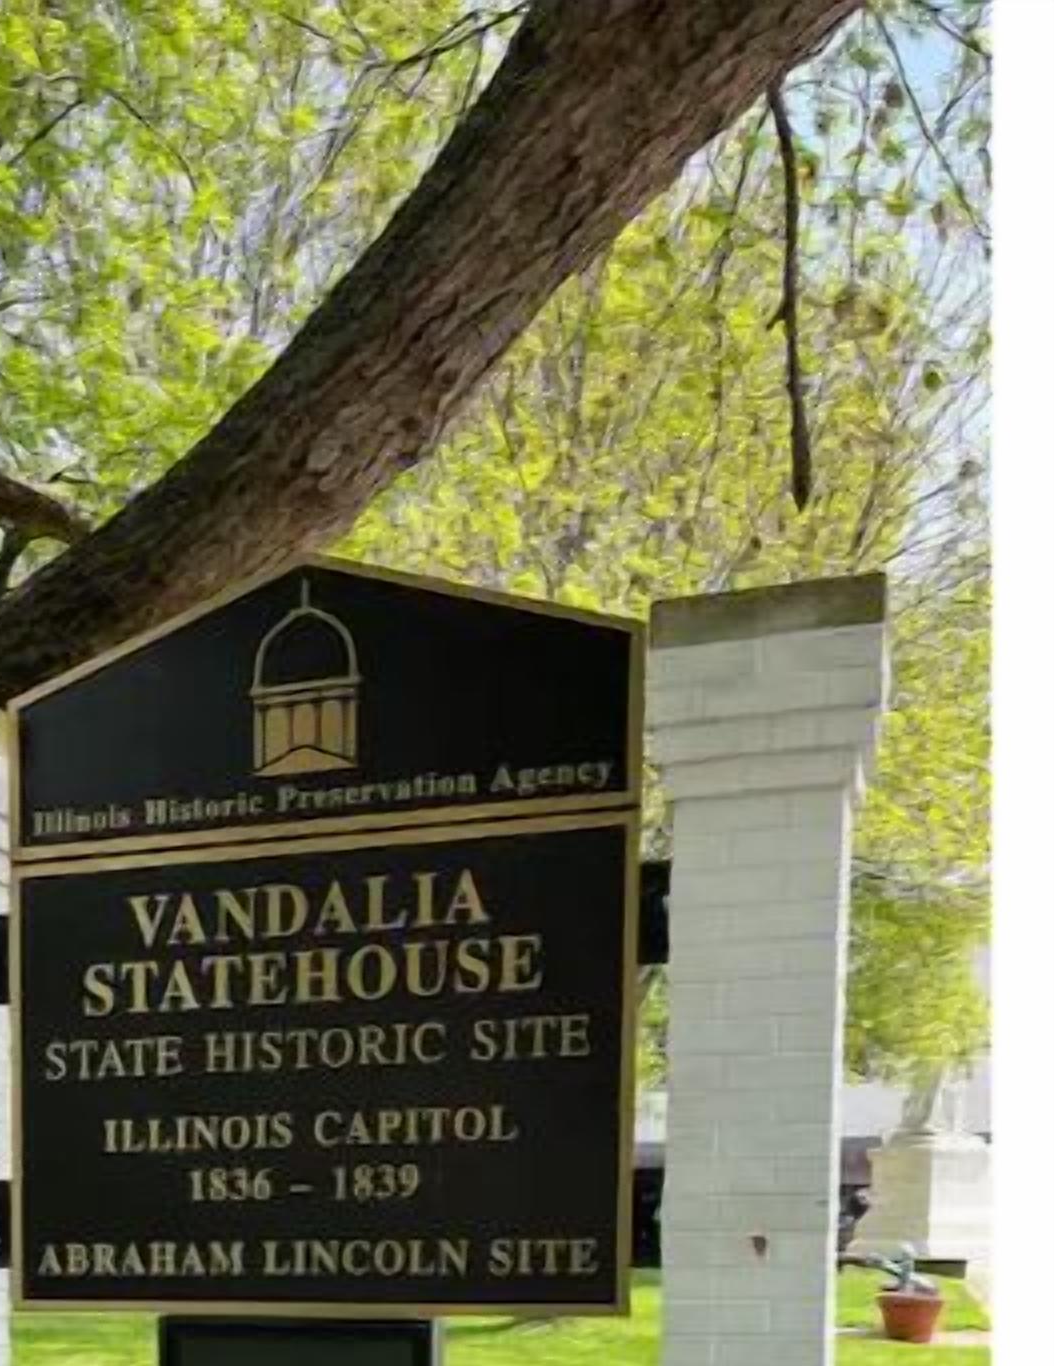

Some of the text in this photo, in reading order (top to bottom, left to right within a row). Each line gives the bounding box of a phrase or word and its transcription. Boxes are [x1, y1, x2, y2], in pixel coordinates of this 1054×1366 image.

[33, 757, 614, 837] Illinois Historic Preservation Agency
[127, 869, 491, 947] VANDALIA
[82, 935, 543, 1018] STATEHOUSE
[45, 1013, 591, 1081] STATE HISTORIC SITE
[103, 1105, 519, 1154] ILLINOIS CAPITOL
[190, 1167, 272, 1202] 1836
[335, 1164, 420, 1201] 1839
[37, 1238, 600, 1277] ABRAHAM LINCOLN SITE
